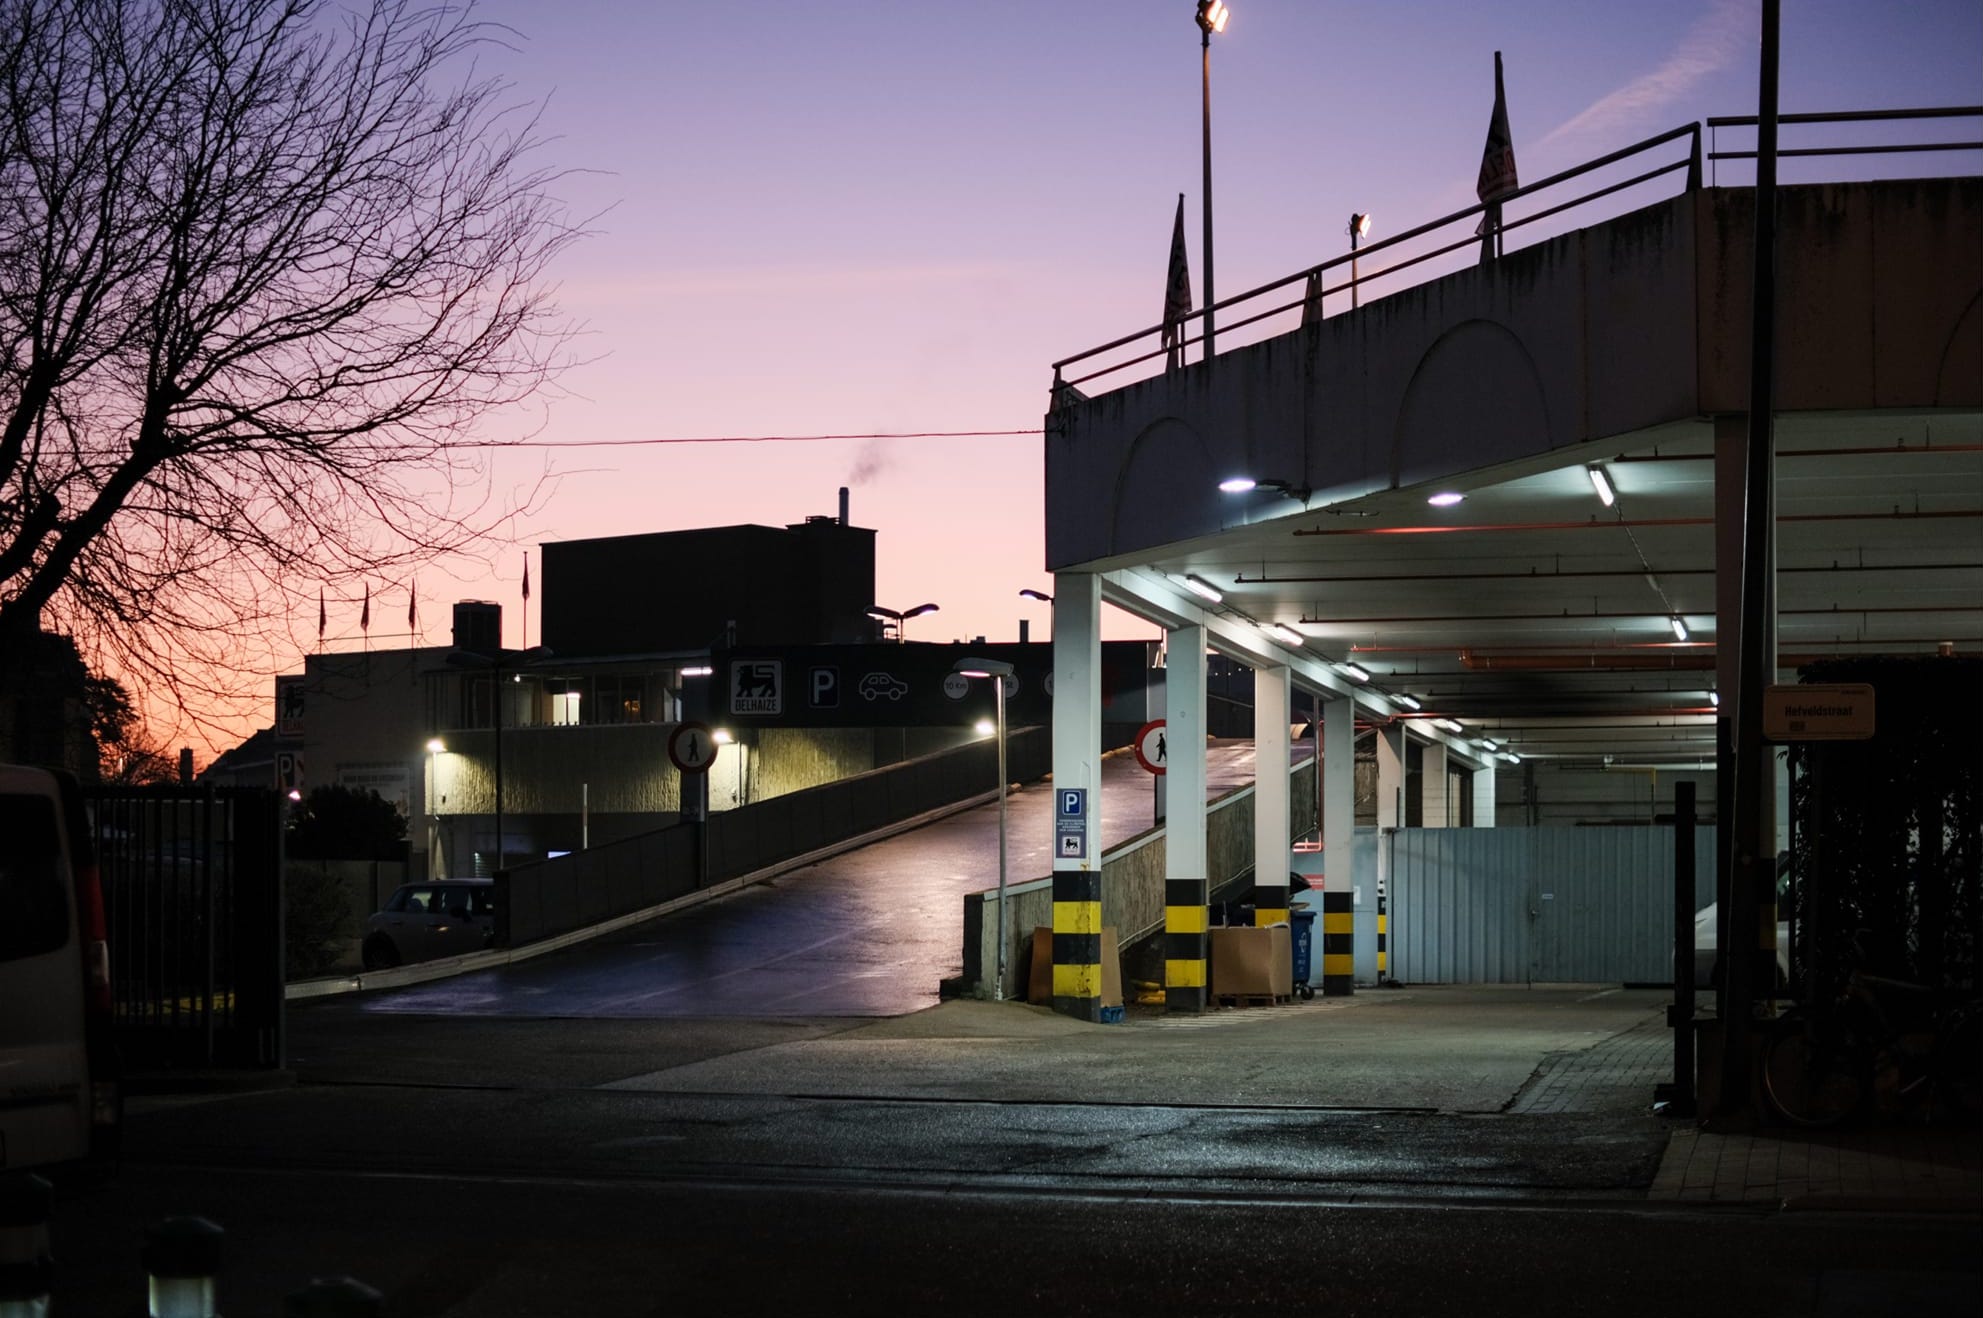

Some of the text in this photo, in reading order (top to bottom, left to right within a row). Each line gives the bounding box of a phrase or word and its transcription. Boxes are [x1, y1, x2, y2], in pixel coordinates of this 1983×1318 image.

[814, 670, 834, 704] P
[735, 698, 776, 711] DELHAIZE
[1066, 792, 1078, 812] P
